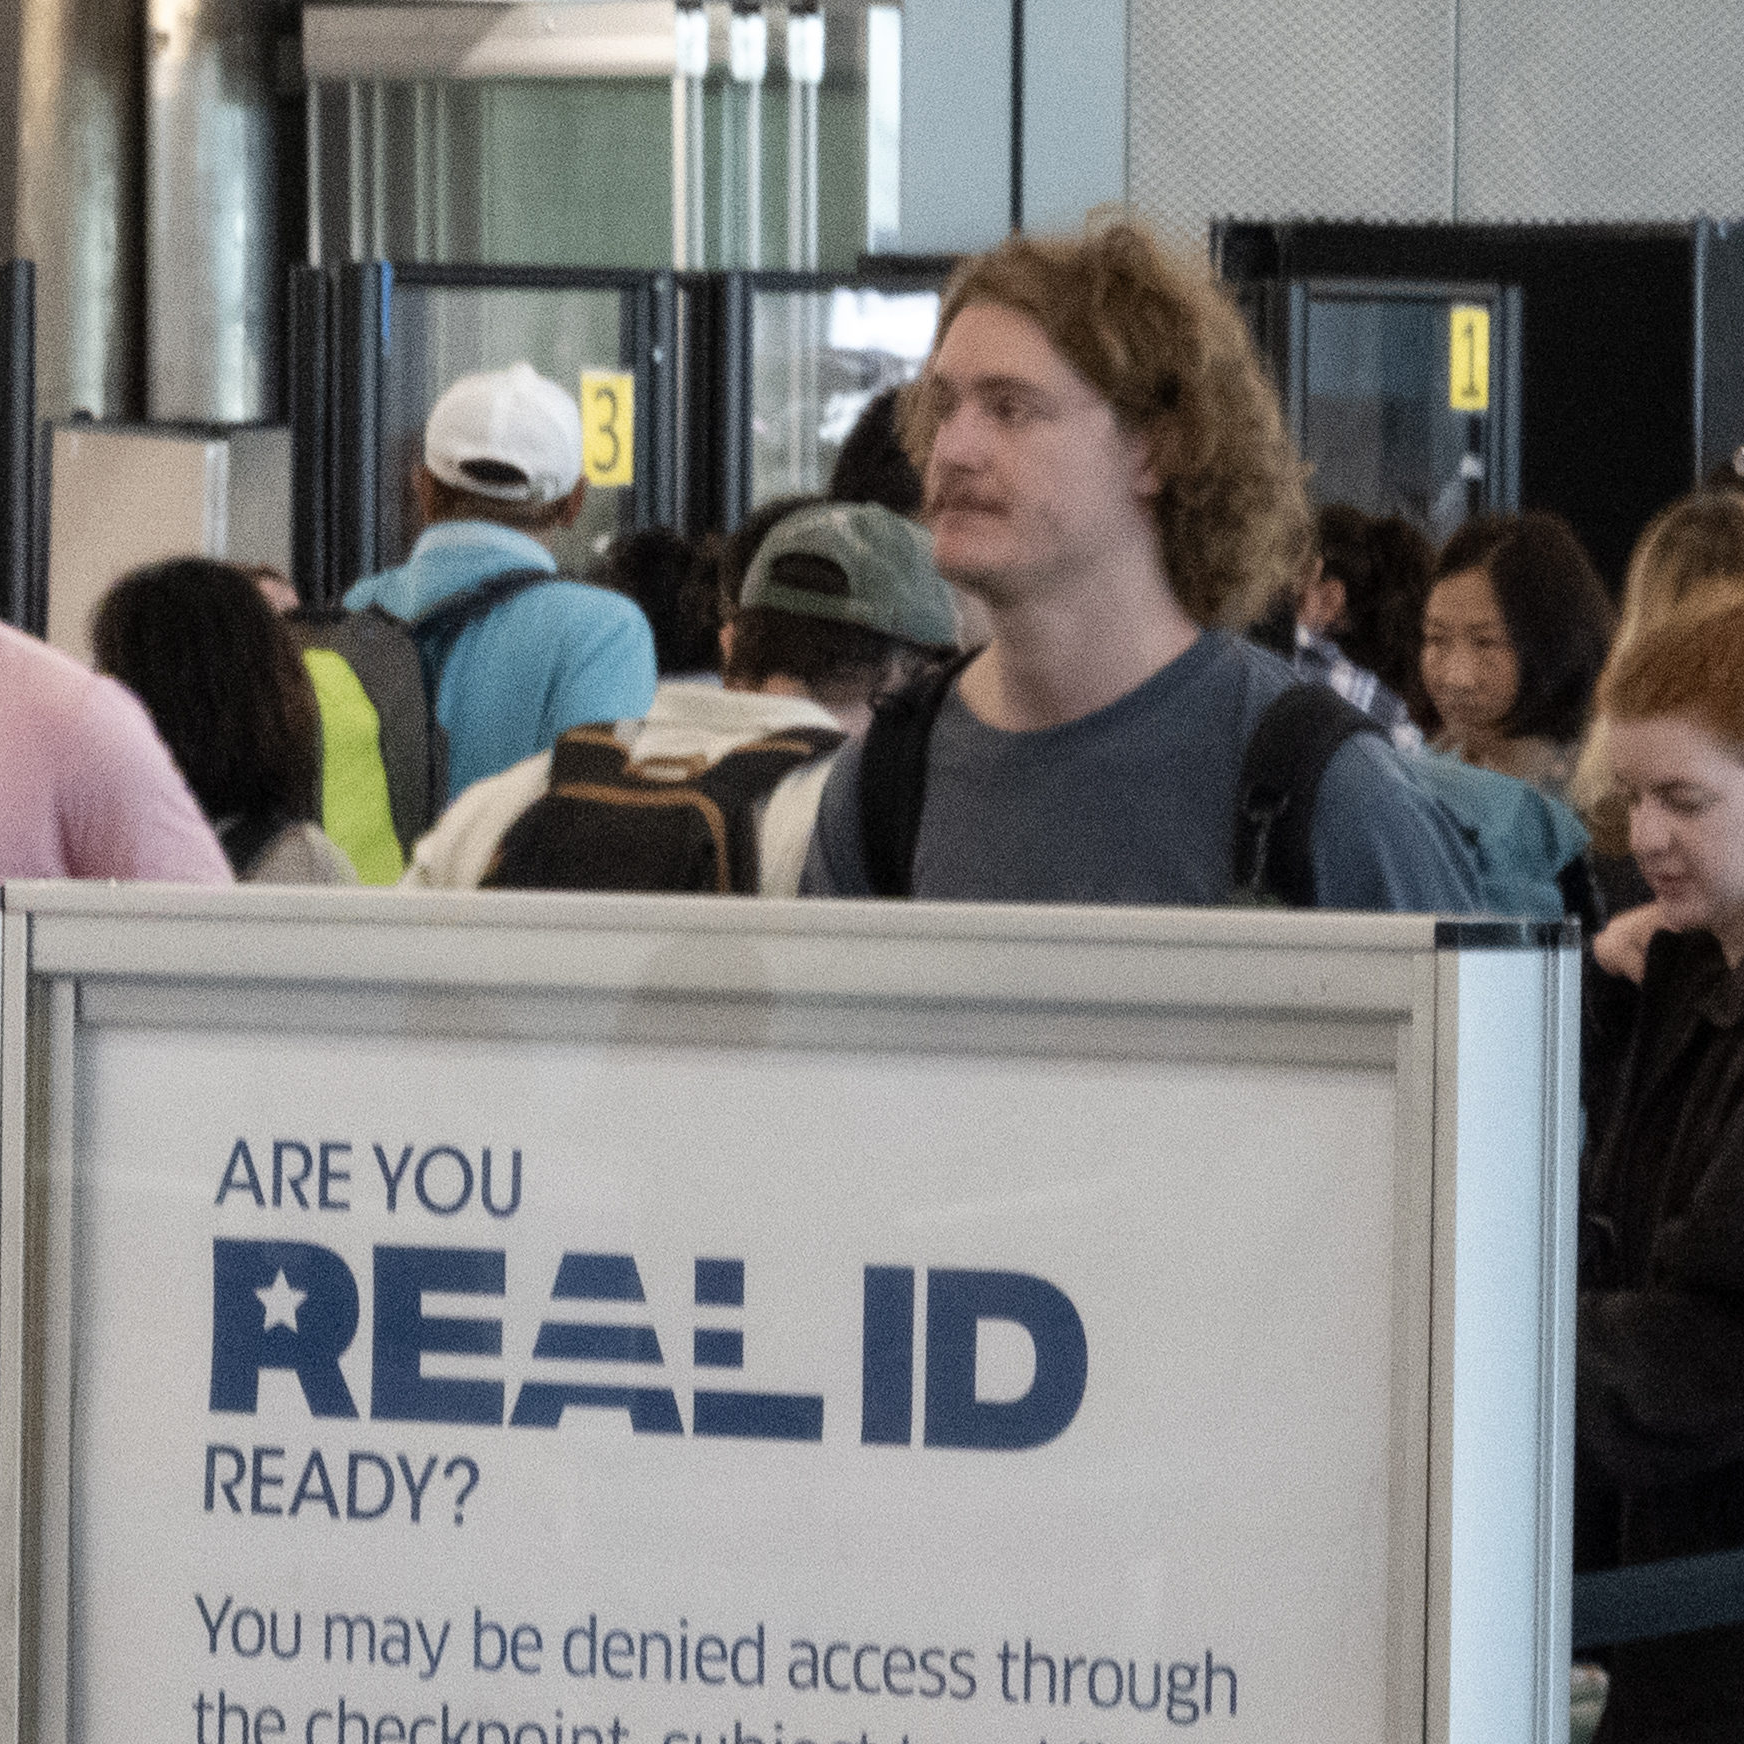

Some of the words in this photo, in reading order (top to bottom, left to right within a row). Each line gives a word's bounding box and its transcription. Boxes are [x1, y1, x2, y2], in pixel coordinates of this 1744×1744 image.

[1448, 303, 1464, 351] 1
[593, 385, 622, 475] 3
[213, 1136, 353, 1213] ARE
[371, 1142, 524, 1221] YOU
[207, 1234, 826, 1445] REAL
[859, 1262, 1090, 1454] ID
[202, 1441, 481, 1527] READY?
[193, 1593, 303, 1662] You
[323, 1612, 452, 1681] may
[472, 1606, 545, 1676] be
[561, 1612, 766, 1688] denied
[786, 1638, 978, 1702] access
[996, 1637, 1239, 1728] through
